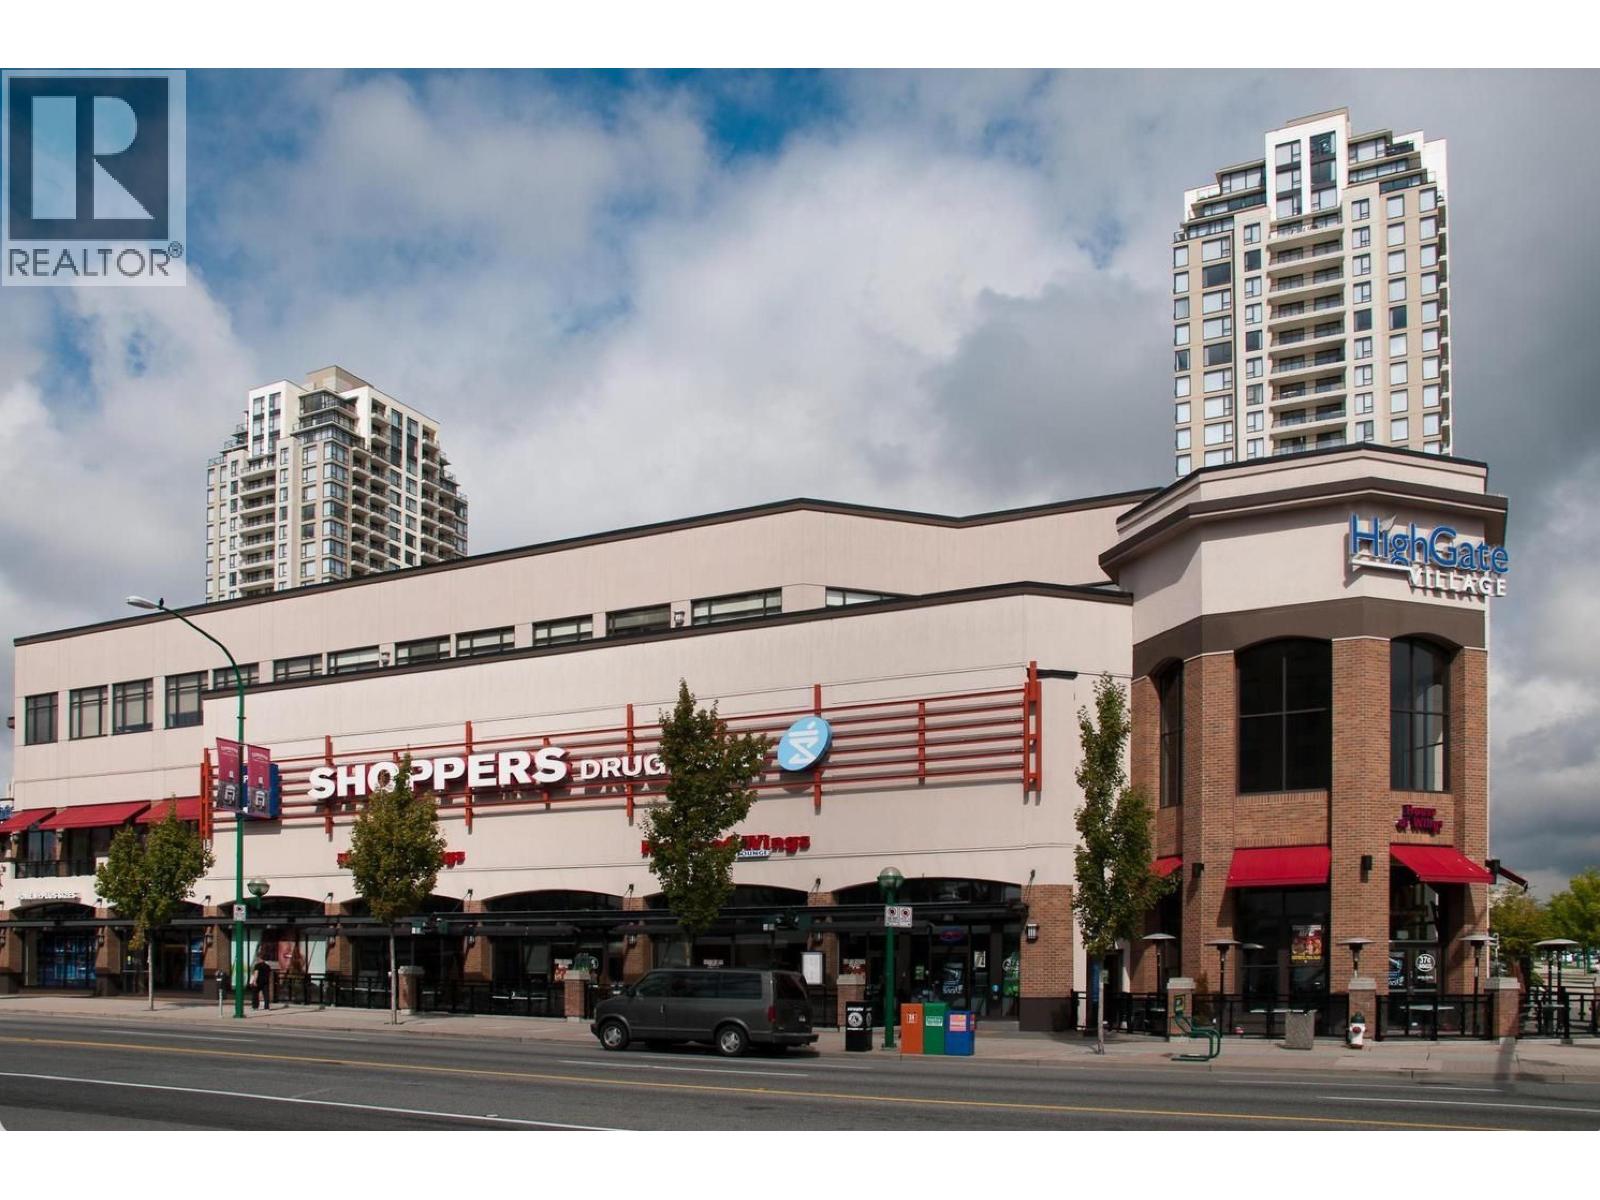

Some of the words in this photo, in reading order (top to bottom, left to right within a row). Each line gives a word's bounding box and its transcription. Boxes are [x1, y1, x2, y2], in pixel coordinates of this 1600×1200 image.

[1350, 512, 1510, 573] HighGate
[1410, 568, 1507, 596] VILLAGE
[307, 746, 569, 801] SHOPPERS
[580, 753, 667, 780] DRUG
